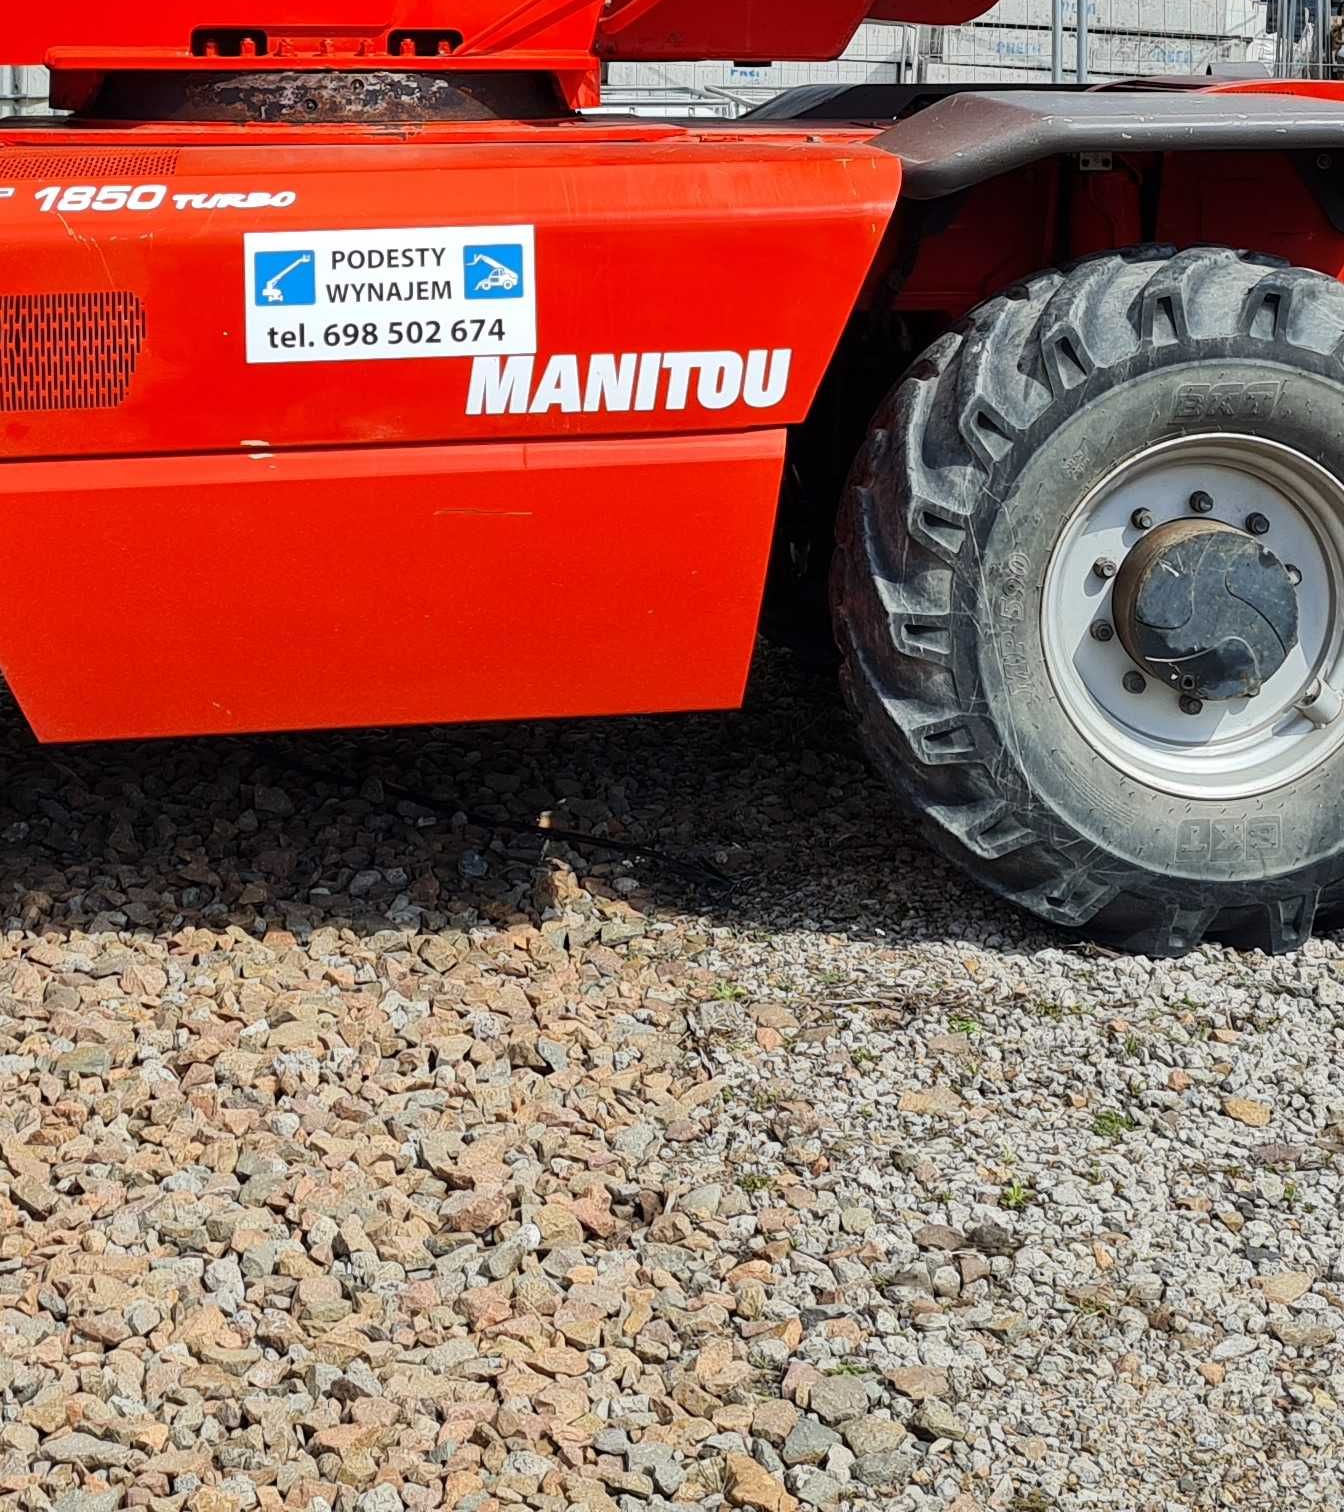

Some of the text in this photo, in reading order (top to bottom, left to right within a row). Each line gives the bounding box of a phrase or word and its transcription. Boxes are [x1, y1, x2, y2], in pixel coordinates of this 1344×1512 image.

[34, 185, 167, 213] 1850
[172, 191, 296, 210] TURBO
[331, 247, 447, 270] PODESTY
[326, 279, 453, 303] WYNAJEM
[267, 318, 506, 348] tel. 698 502 674
[465, 349, 792, 416] MANITOU
